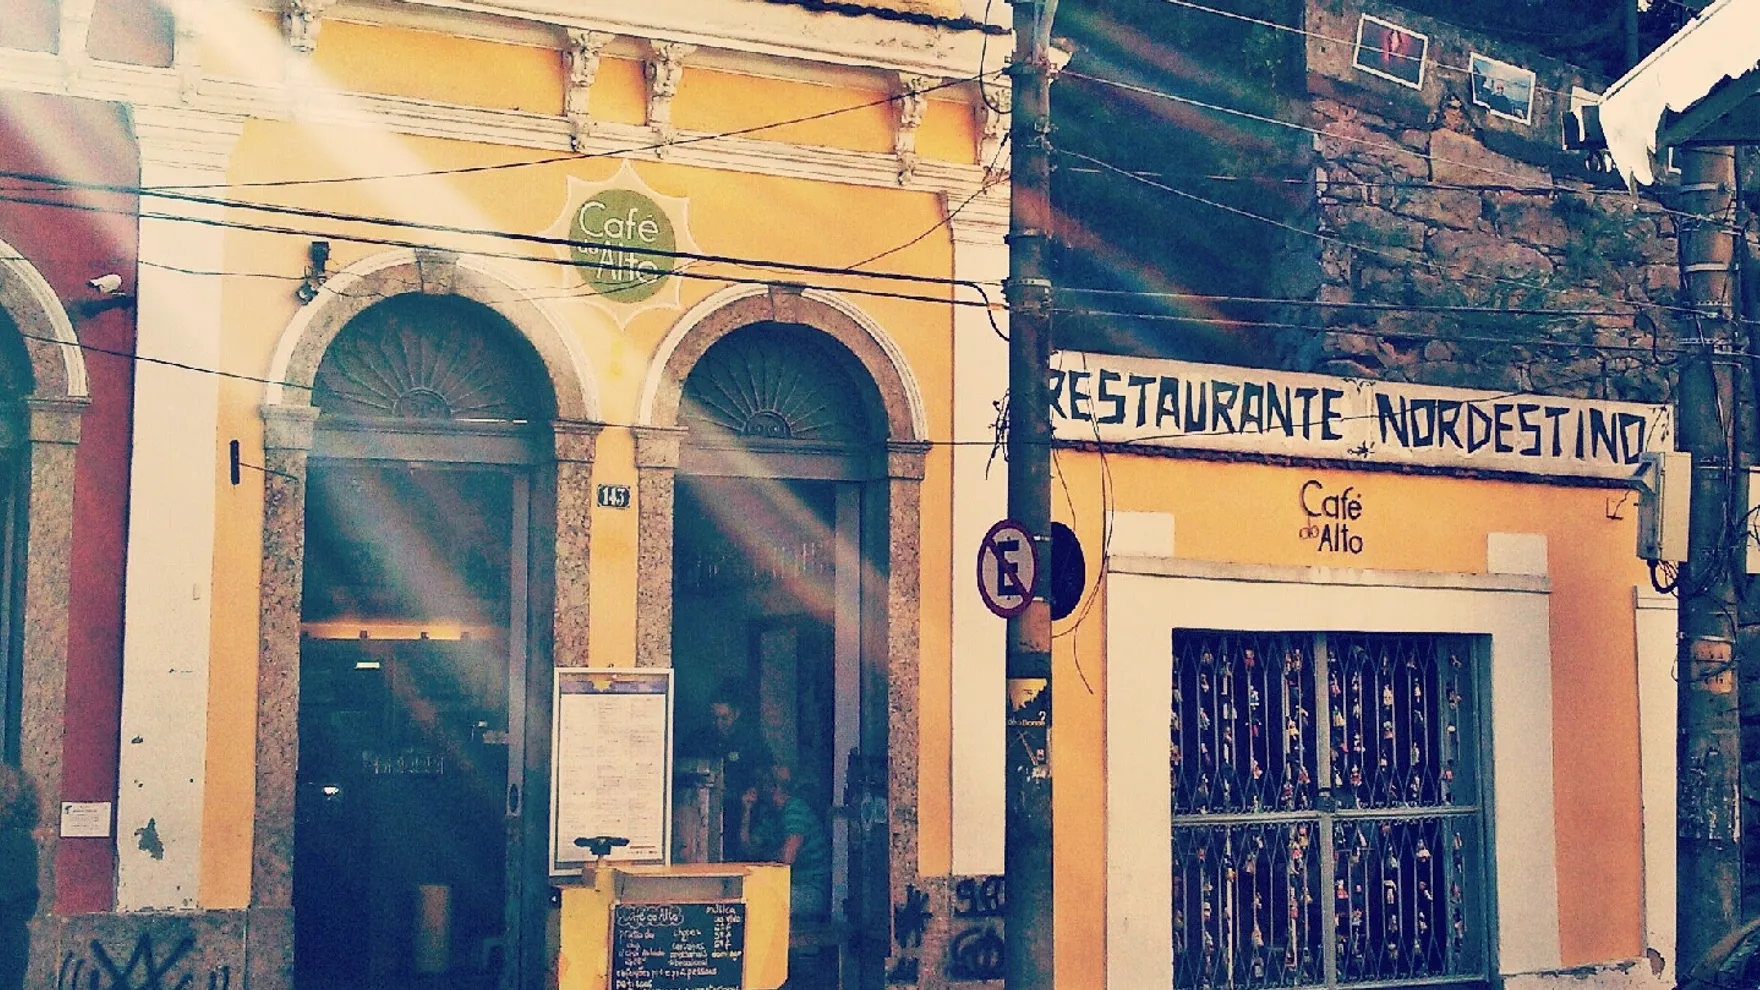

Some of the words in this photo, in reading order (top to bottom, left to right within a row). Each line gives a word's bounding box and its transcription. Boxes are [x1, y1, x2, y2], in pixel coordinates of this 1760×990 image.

[579, 200, 659, 243] Café
[596, 240, 660, 284] Alto
[1049, 367, 1344, 441] RESTAURANTE
[1375, 392, 1647, 465] NORDESTINO
[1299, 479, 1363, 521] Café
[1317, 522, 1364, 554] Alto
[996, 539, 1020, 596] E
